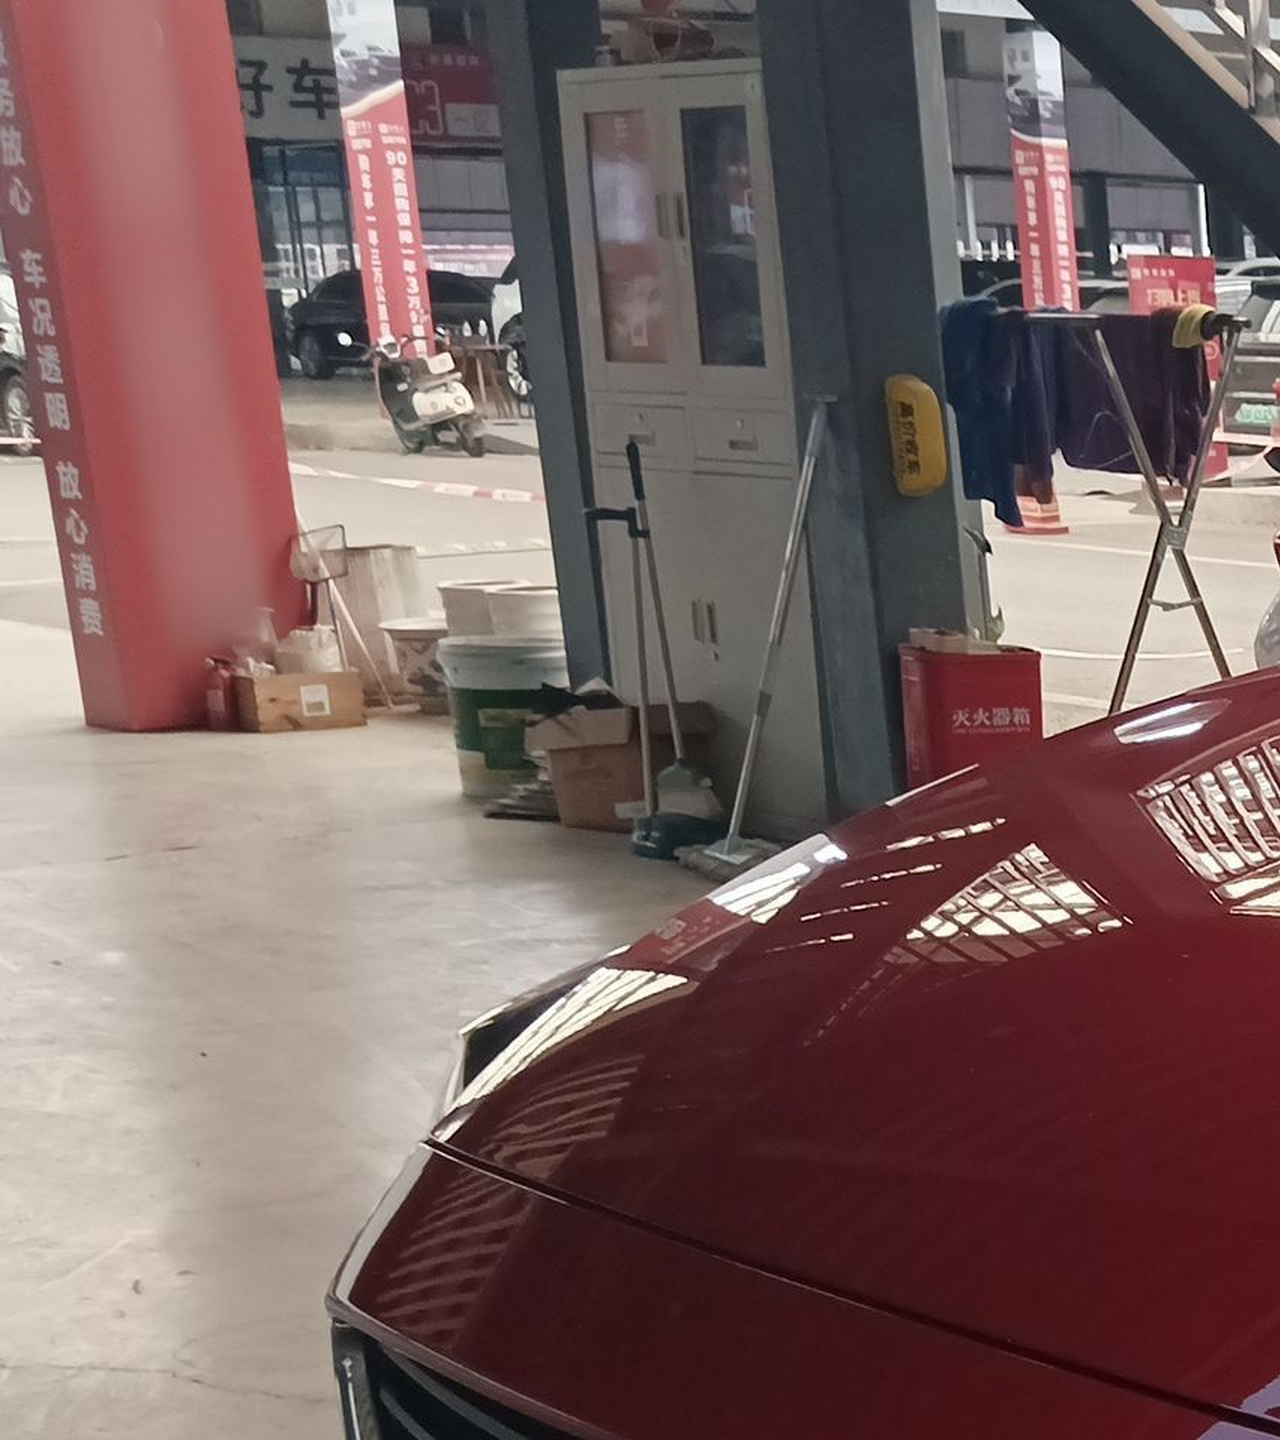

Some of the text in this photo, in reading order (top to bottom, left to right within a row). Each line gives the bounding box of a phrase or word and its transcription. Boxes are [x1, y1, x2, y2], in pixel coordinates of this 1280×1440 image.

[20, 248, 71, 432] 车况透明
[56, 460, 104, 637] 放心消费
[952, 707, 1032, 728] 灭火器箱
